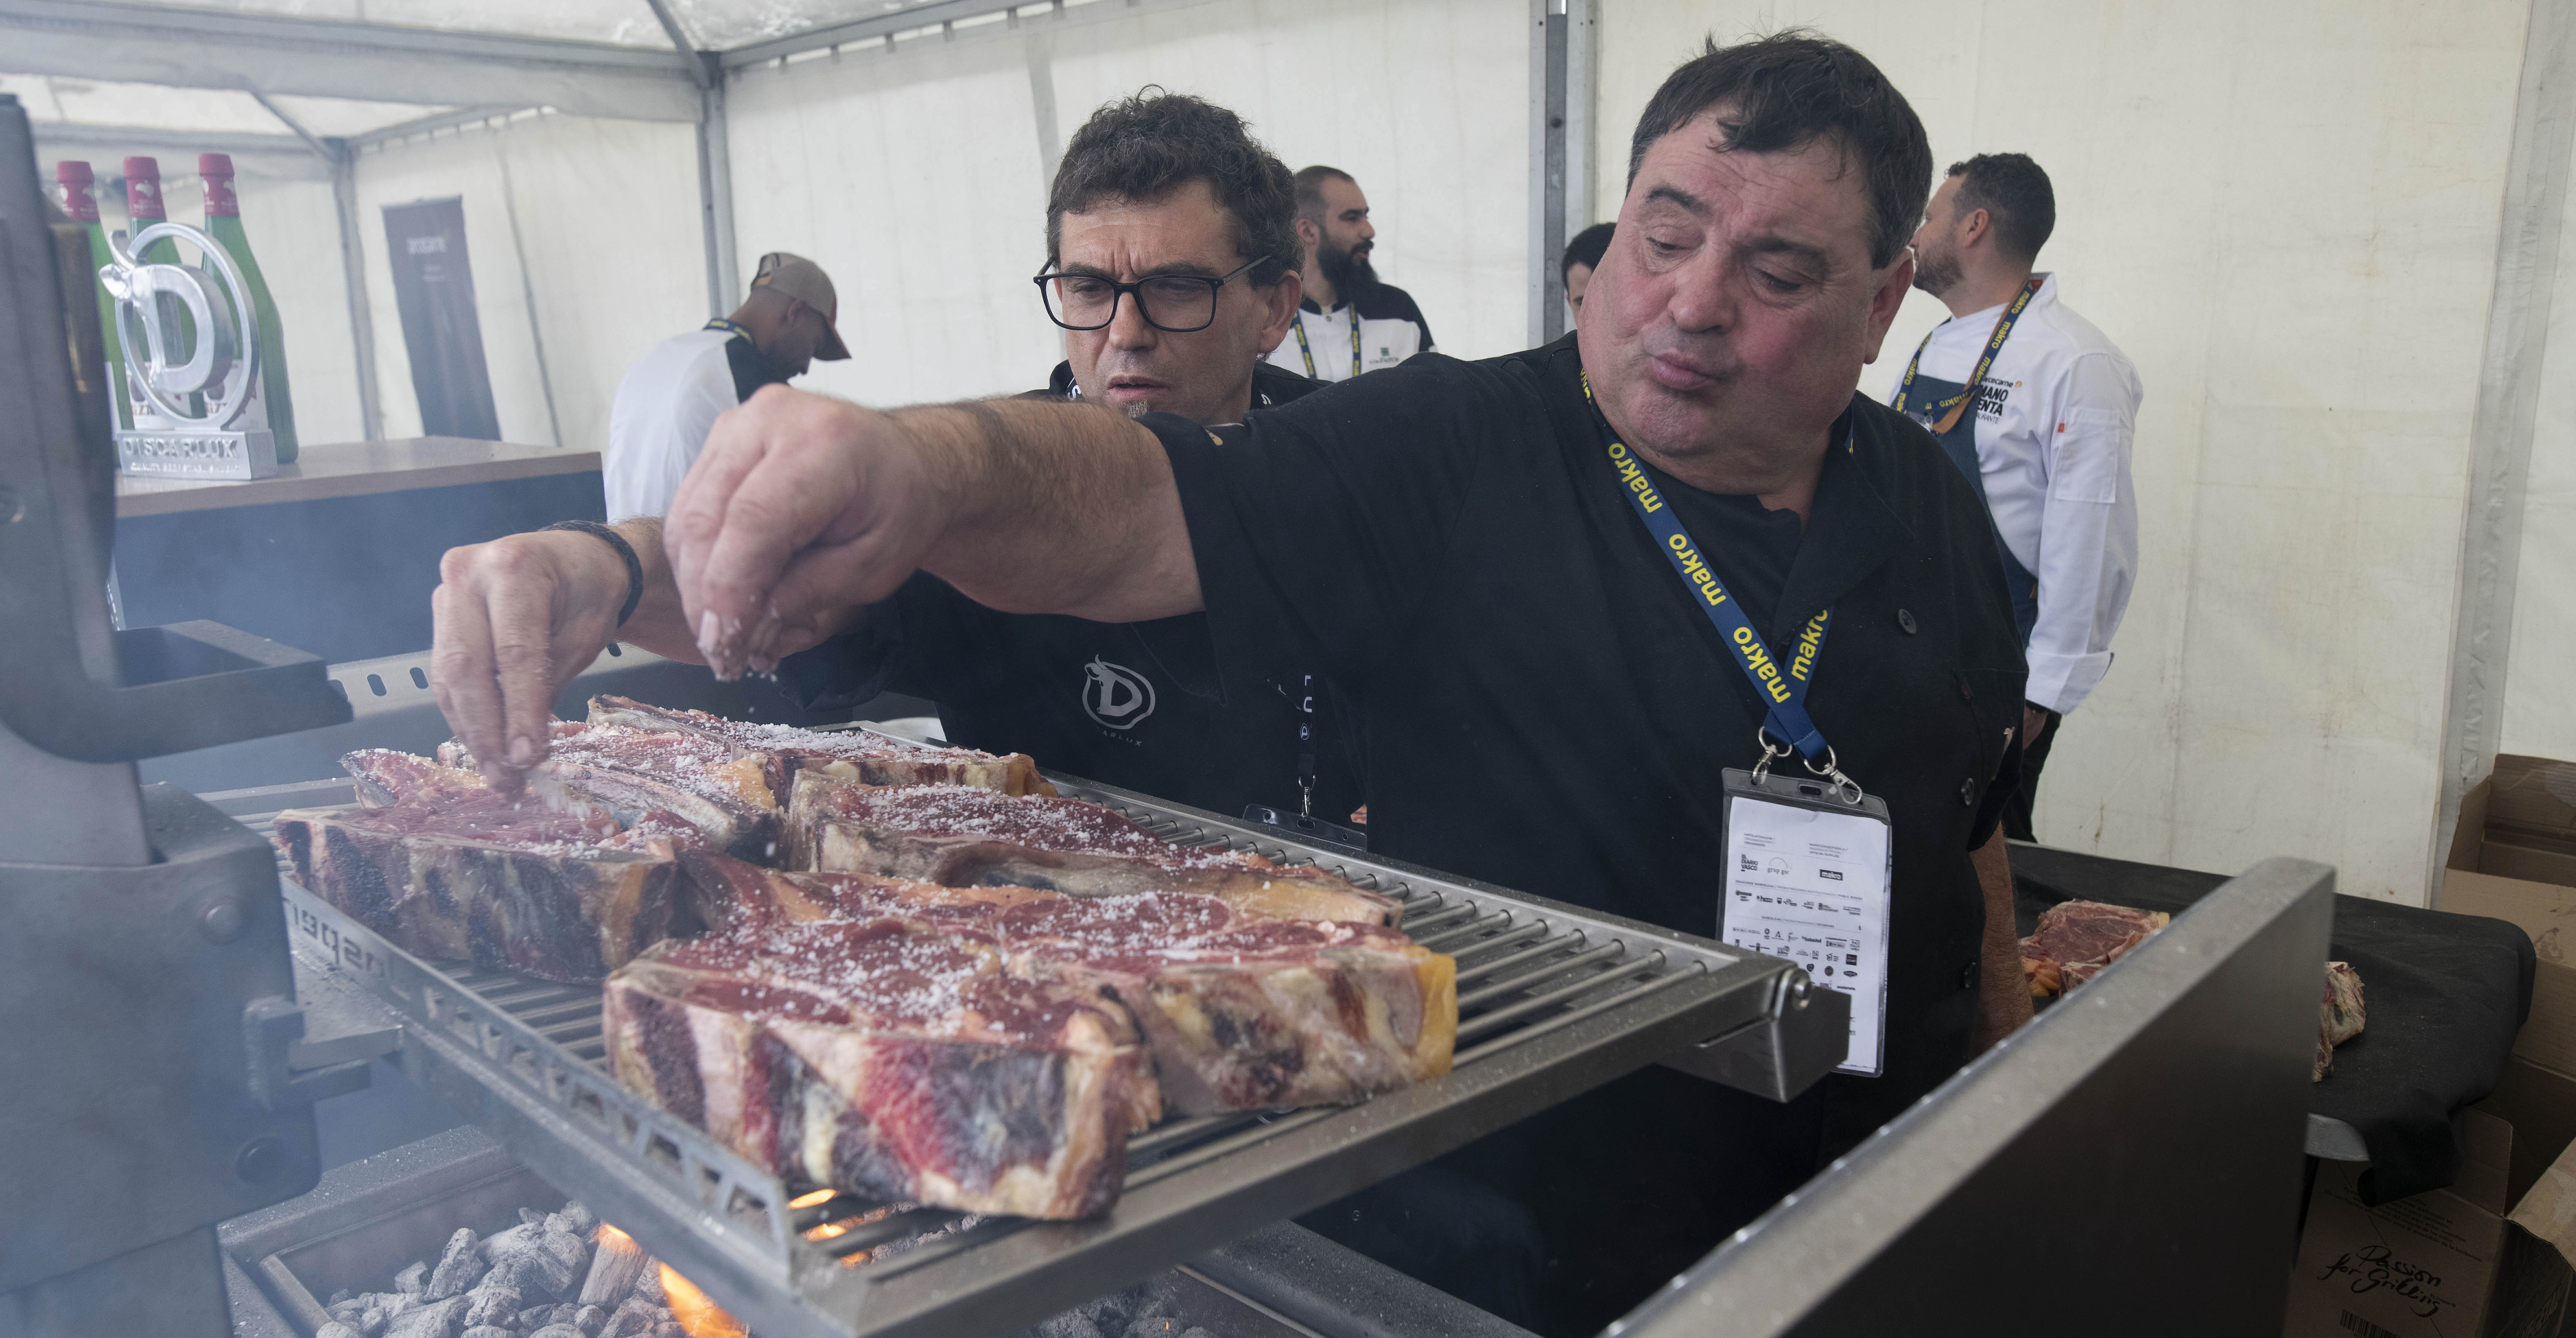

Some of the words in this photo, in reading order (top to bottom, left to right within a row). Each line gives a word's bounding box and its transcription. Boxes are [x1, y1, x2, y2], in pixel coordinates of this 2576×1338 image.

[1992, 321, 2011, 350] makro
[1904, 358, 1917, 386] makro
[123, 437, 238, 458] DISCARLUX
[1608, 442, 1663, 513] makro
[1668, 533, 1726, 606] makro
[1733, 626, 1792, 704] makro
[2317, 1253, 2362, 1281] for
[2351, 1269, 2440, 1317] Grilling
[2356, 1245, 2441, 1287] Passion
